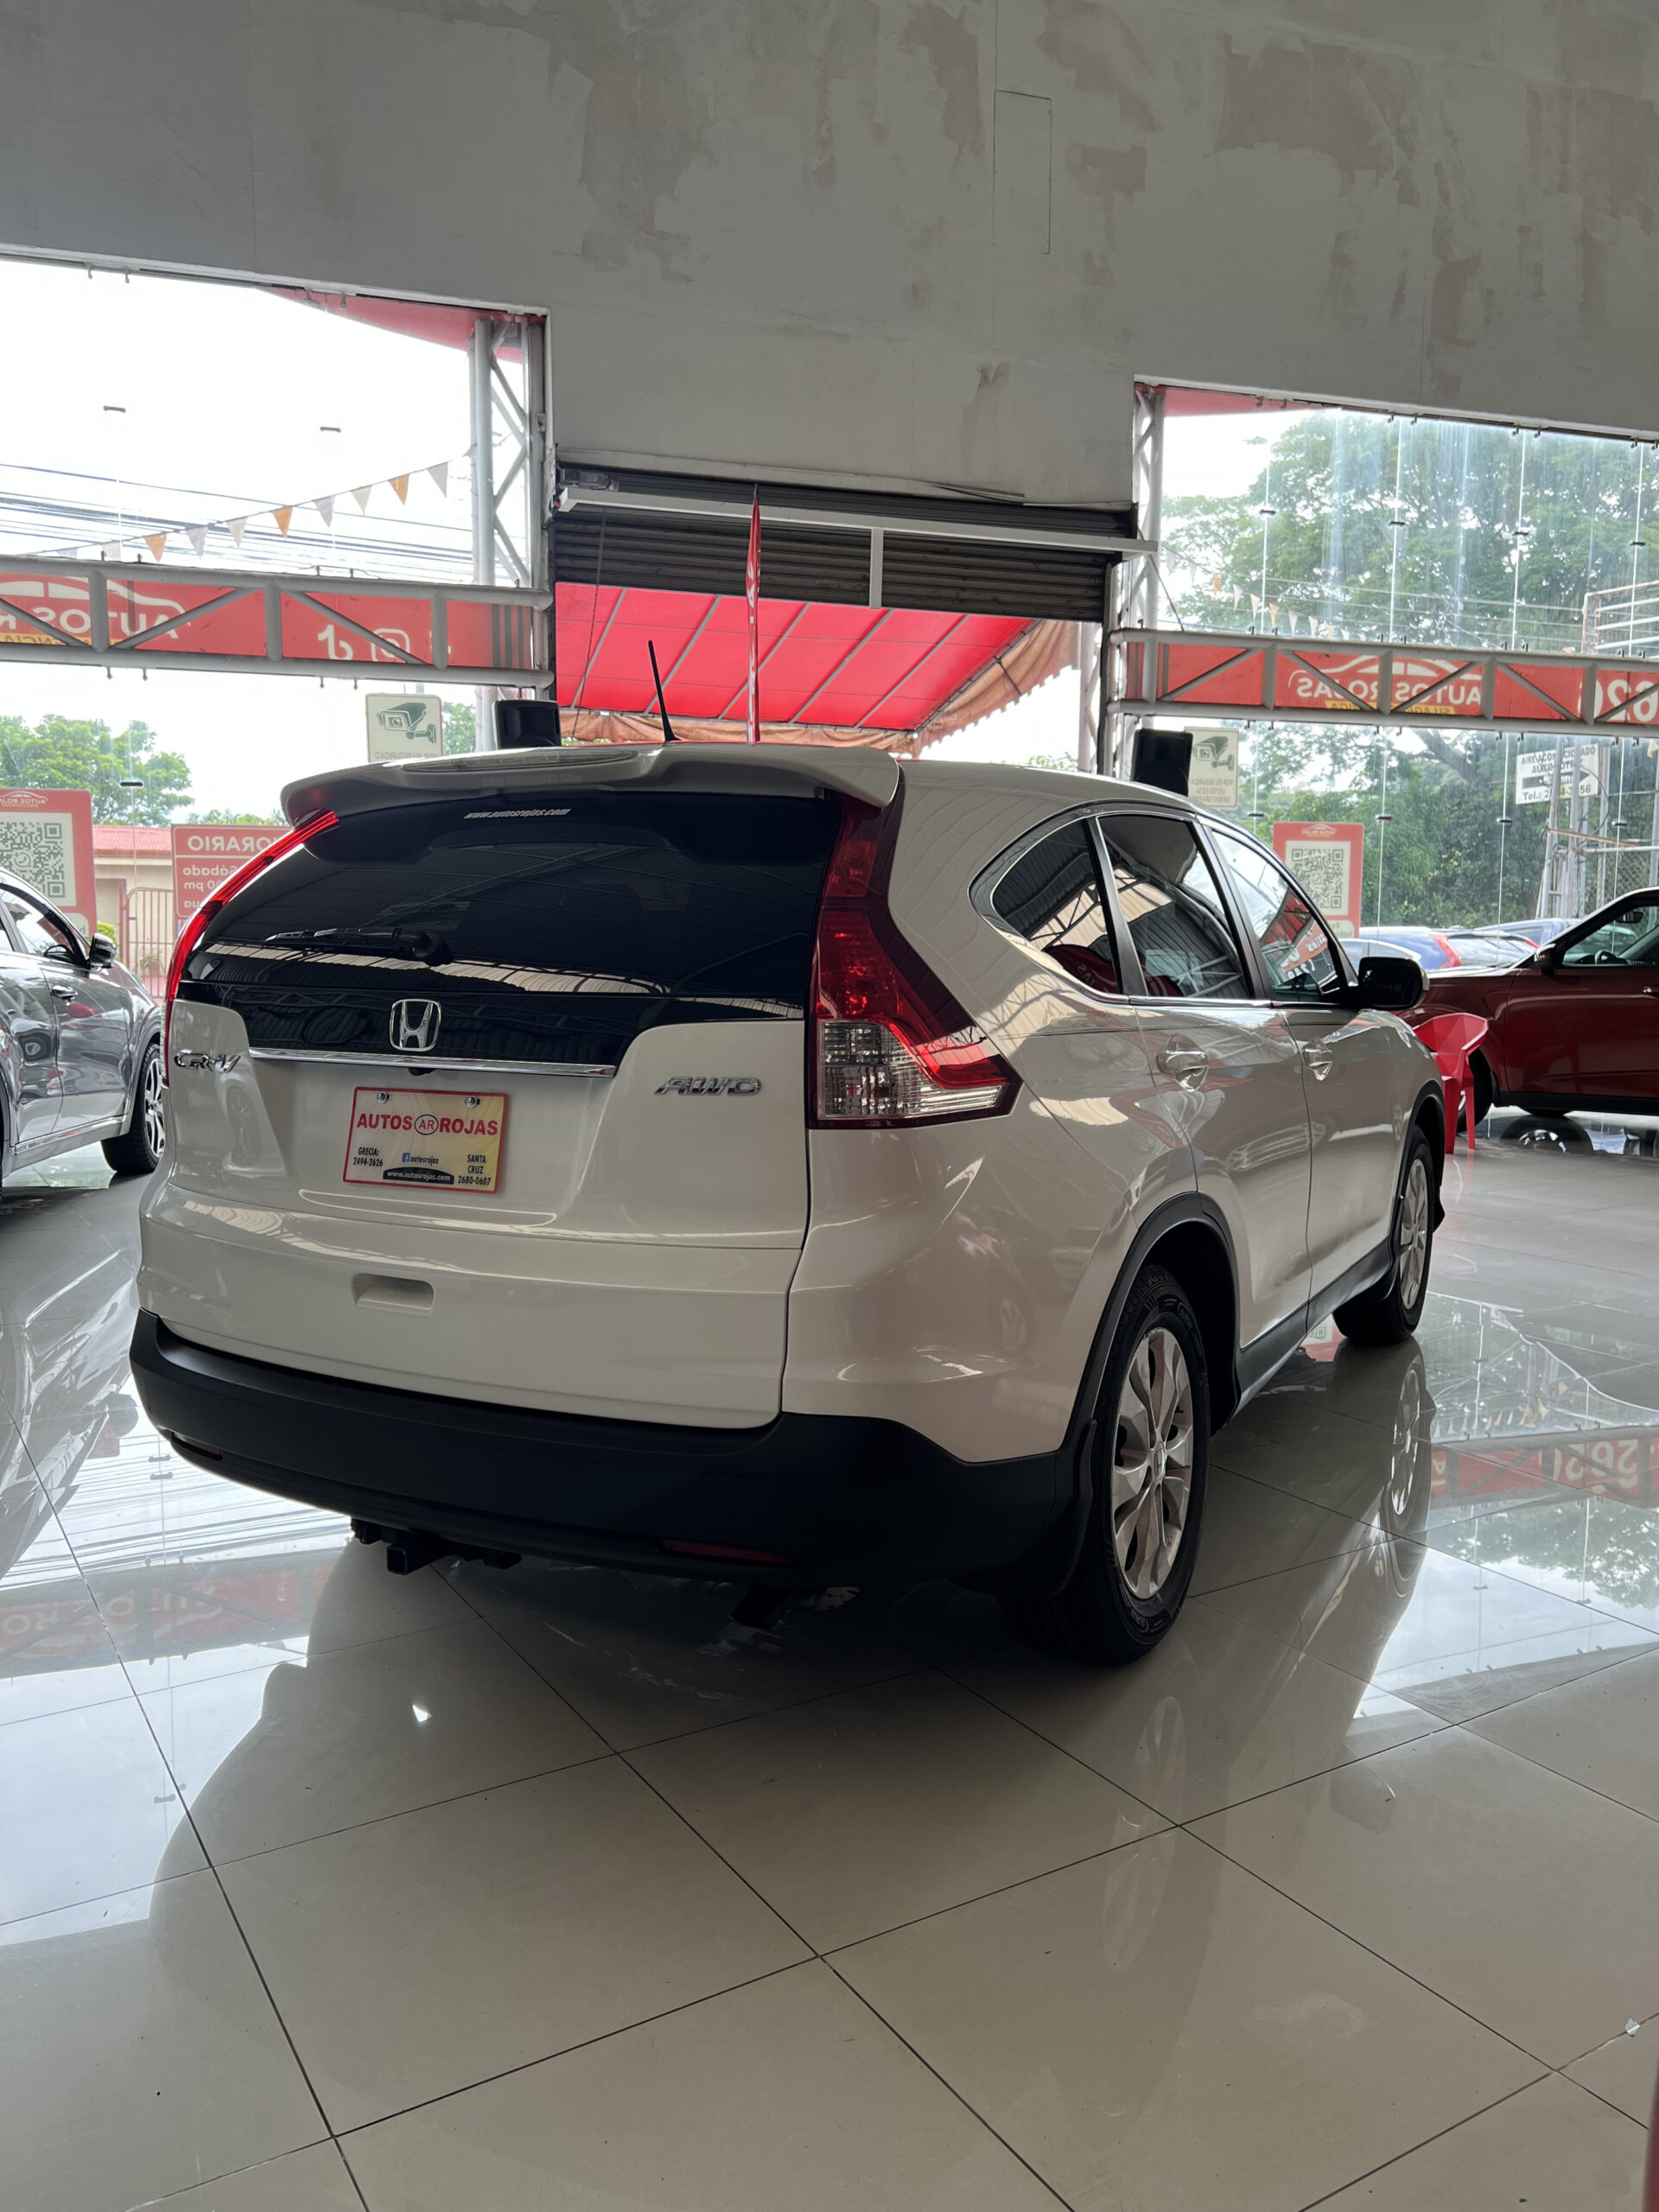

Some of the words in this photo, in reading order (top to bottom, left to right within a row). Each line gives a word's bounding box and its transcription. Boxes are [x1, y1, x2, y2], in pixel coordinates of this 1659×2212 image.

[463, 808, 571, 819] www.autosrojas.com
[174, 1049, 241, 1073] CR-V
[654, 1077, 762, 1096] AWD
[356, 1113, 413, 1131] AUTOS
[418, 1119, 435, 1130] AR
[439, 1117, 499, 1136] ROJAS
[358, 1147, 380, 1156] GRECIA:
[353, 1157, 384, 1167] 2494-2626
[410, 1155, 439, 1166] autosrojas
[467, 1154, 486, 1164] SANTA
[467, 1166, 484, 1174] CRUZ
[386, 1170, 451, 1182] www.autosrojas.com
[457, 1175, 492, 1186] 2680-0607
